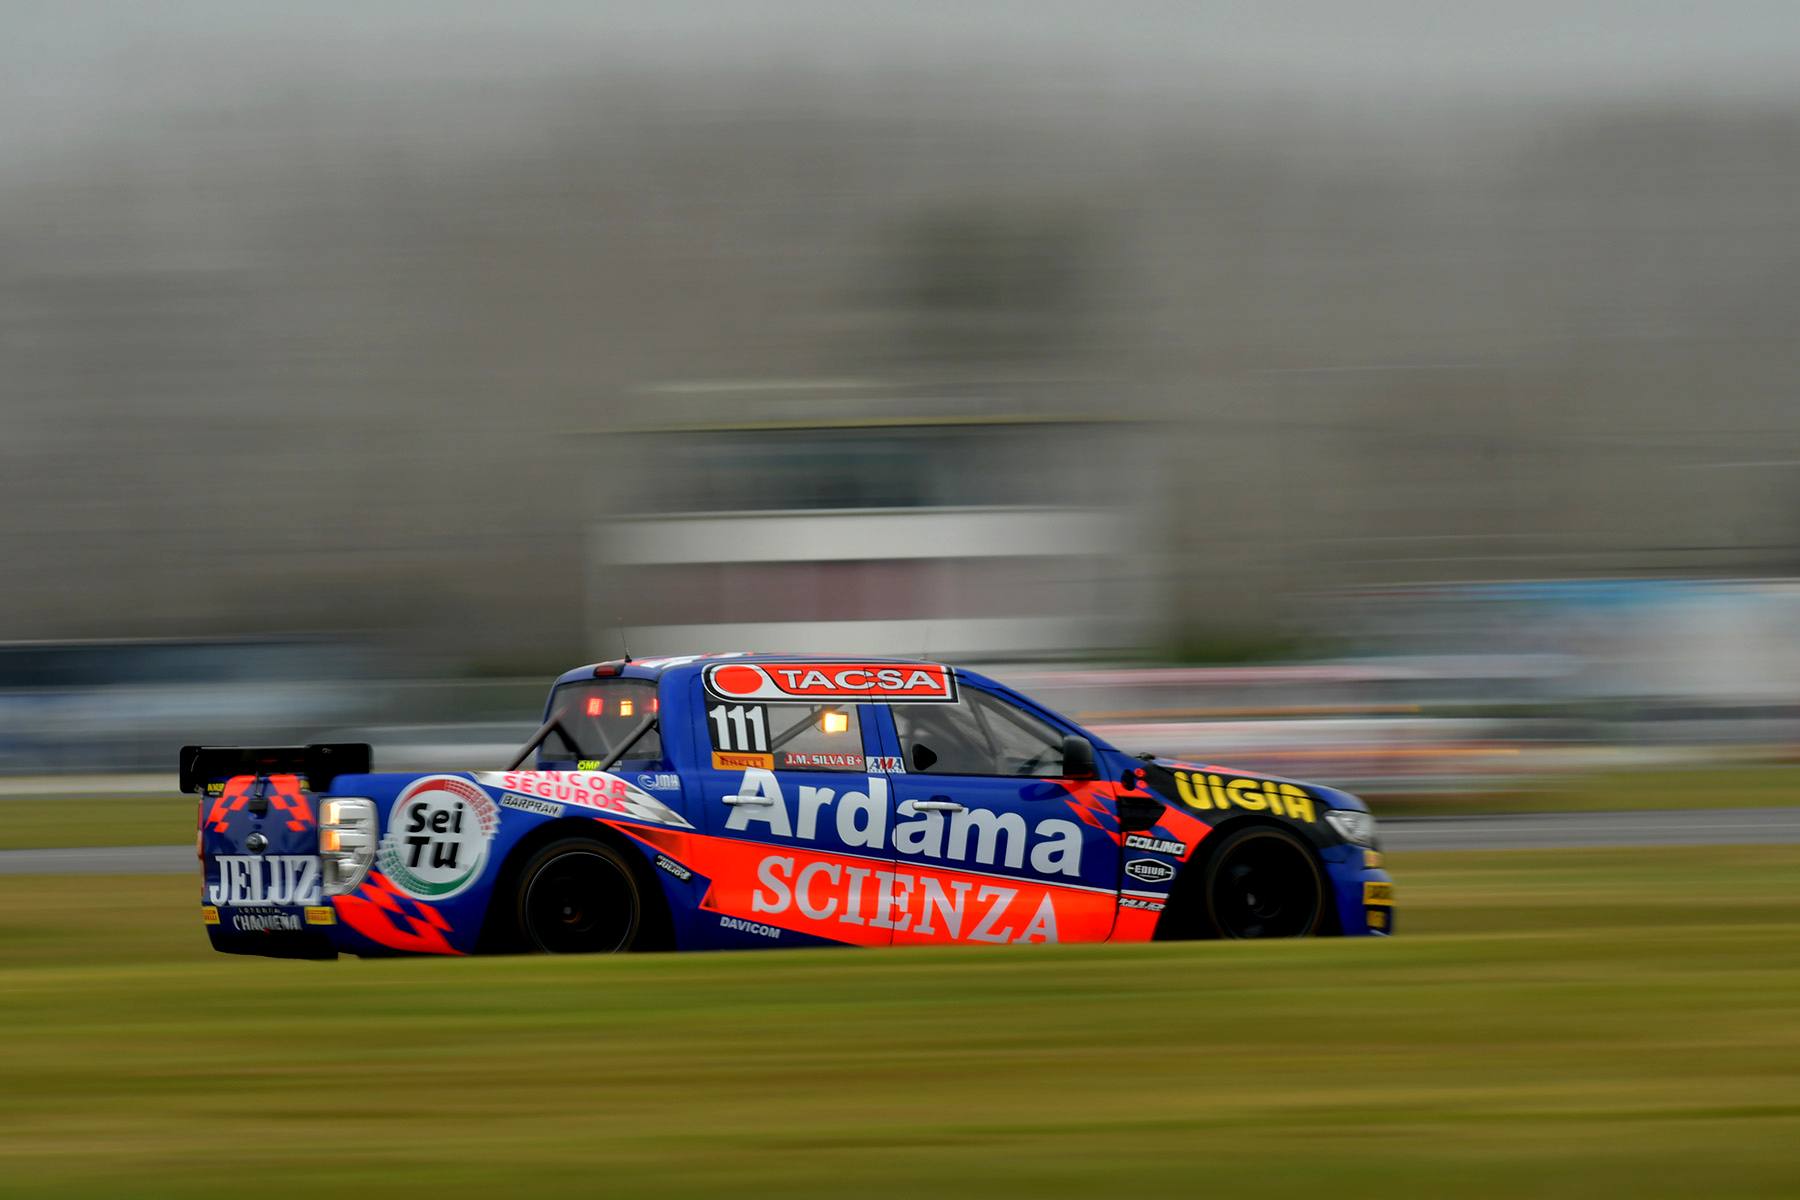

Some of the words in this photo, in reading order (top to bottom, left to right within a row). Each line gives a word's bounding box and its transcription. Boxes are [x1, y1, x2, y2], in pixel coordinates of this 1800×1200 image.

[778, 669, 942, 690] TACSA
[709, 704, 767, 751] 111
[812, 754, 844, 766] SILVA
[870, 757, 902, 770] AMA
[503, 775, 625, 813] SEGUROS
[405, 802, 463, 834] Sei
[724, 767, 1083, 877] Ardama
[403, 836, 460, 869] Tu
[1125, 835, 1186, 855] COLLINO
[209, 855, 321, 907] JELUZ
[752, 855, 1059, 944] SCIENZA
[720, 916, 781, 939] DAVICOM
